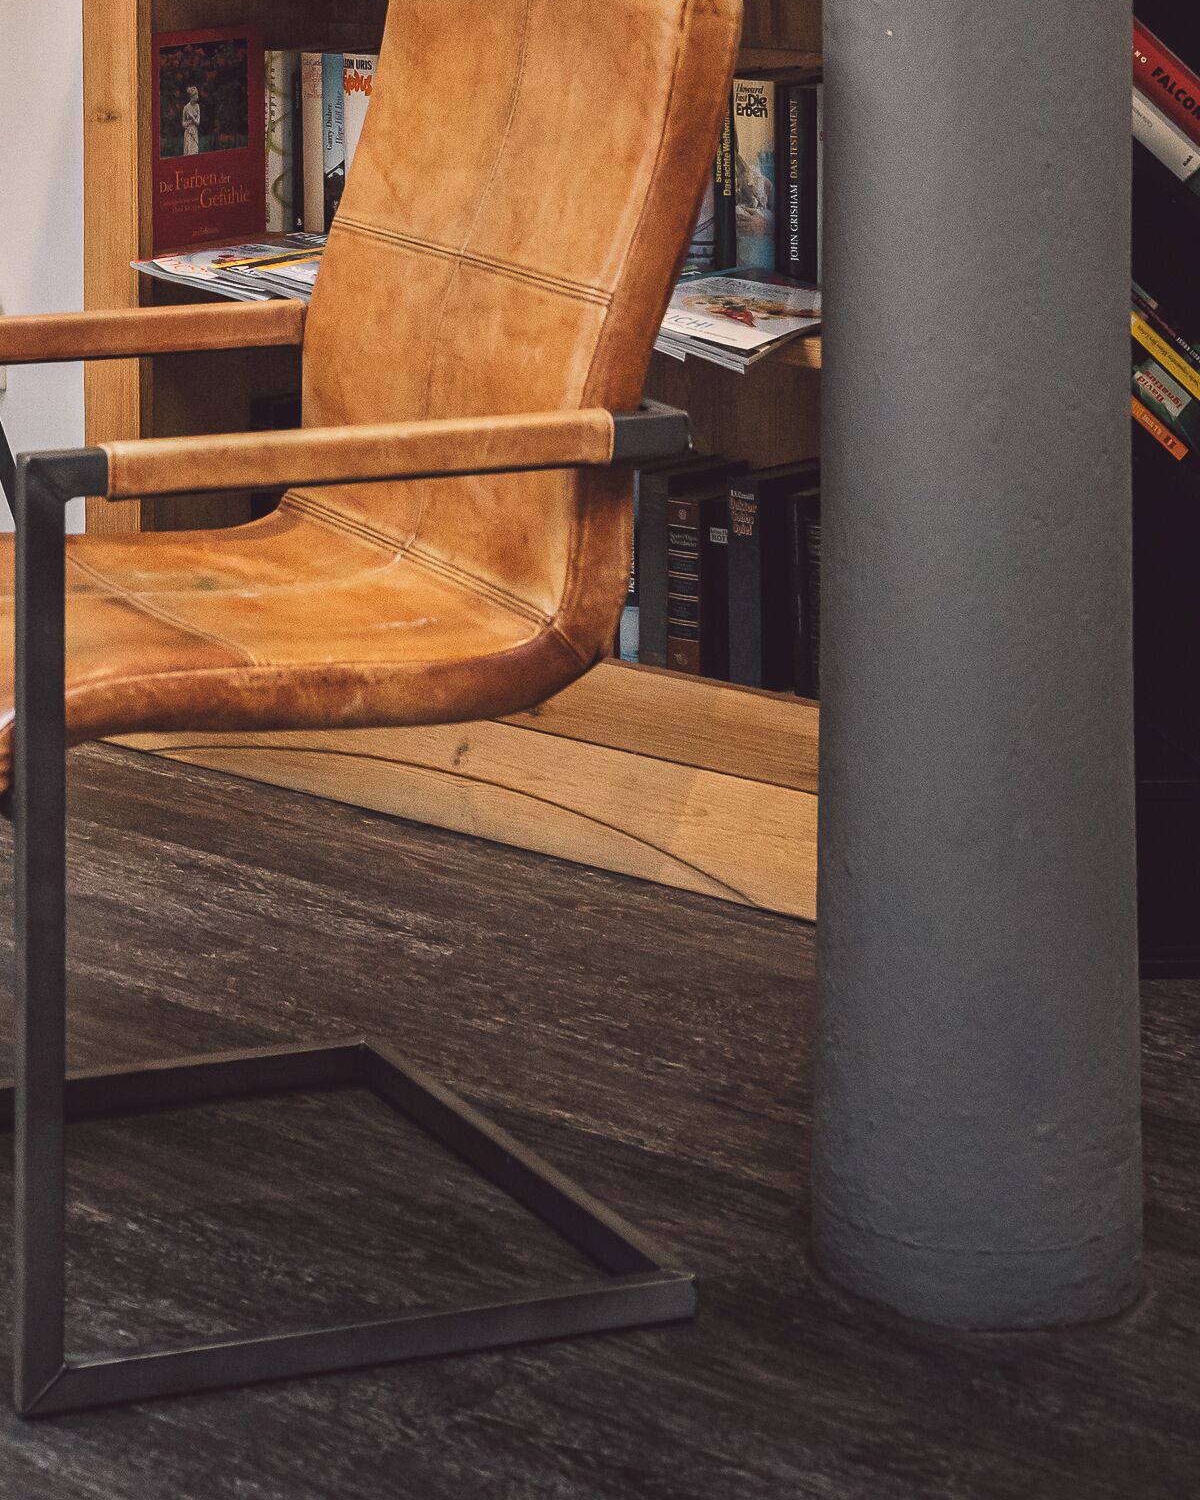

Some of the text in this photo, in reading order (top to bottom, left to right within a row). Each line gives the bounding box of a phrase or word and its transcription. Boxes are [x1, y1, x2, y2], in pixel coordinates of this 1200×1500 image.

[356, 59, 373, 70] URIS
[736, 83, 764, 94] Howard
[747, 93, 768, 107] Die
[736, 102, 768, 118] Erben
[325, 104, 334, 151] Garry Disher
[723, 153, 731, 178] achte
[160, 181, 174, 195] Die
[175, 168, 217, 190] Farben
[723, 179, 731, 197] Das
[789, 99, 798, 261] JOHN GRISHAM DAS TESTAMENT
[1136, 375, 1165, 402] David
[1142, 370, 1184, 409] Ignatius
